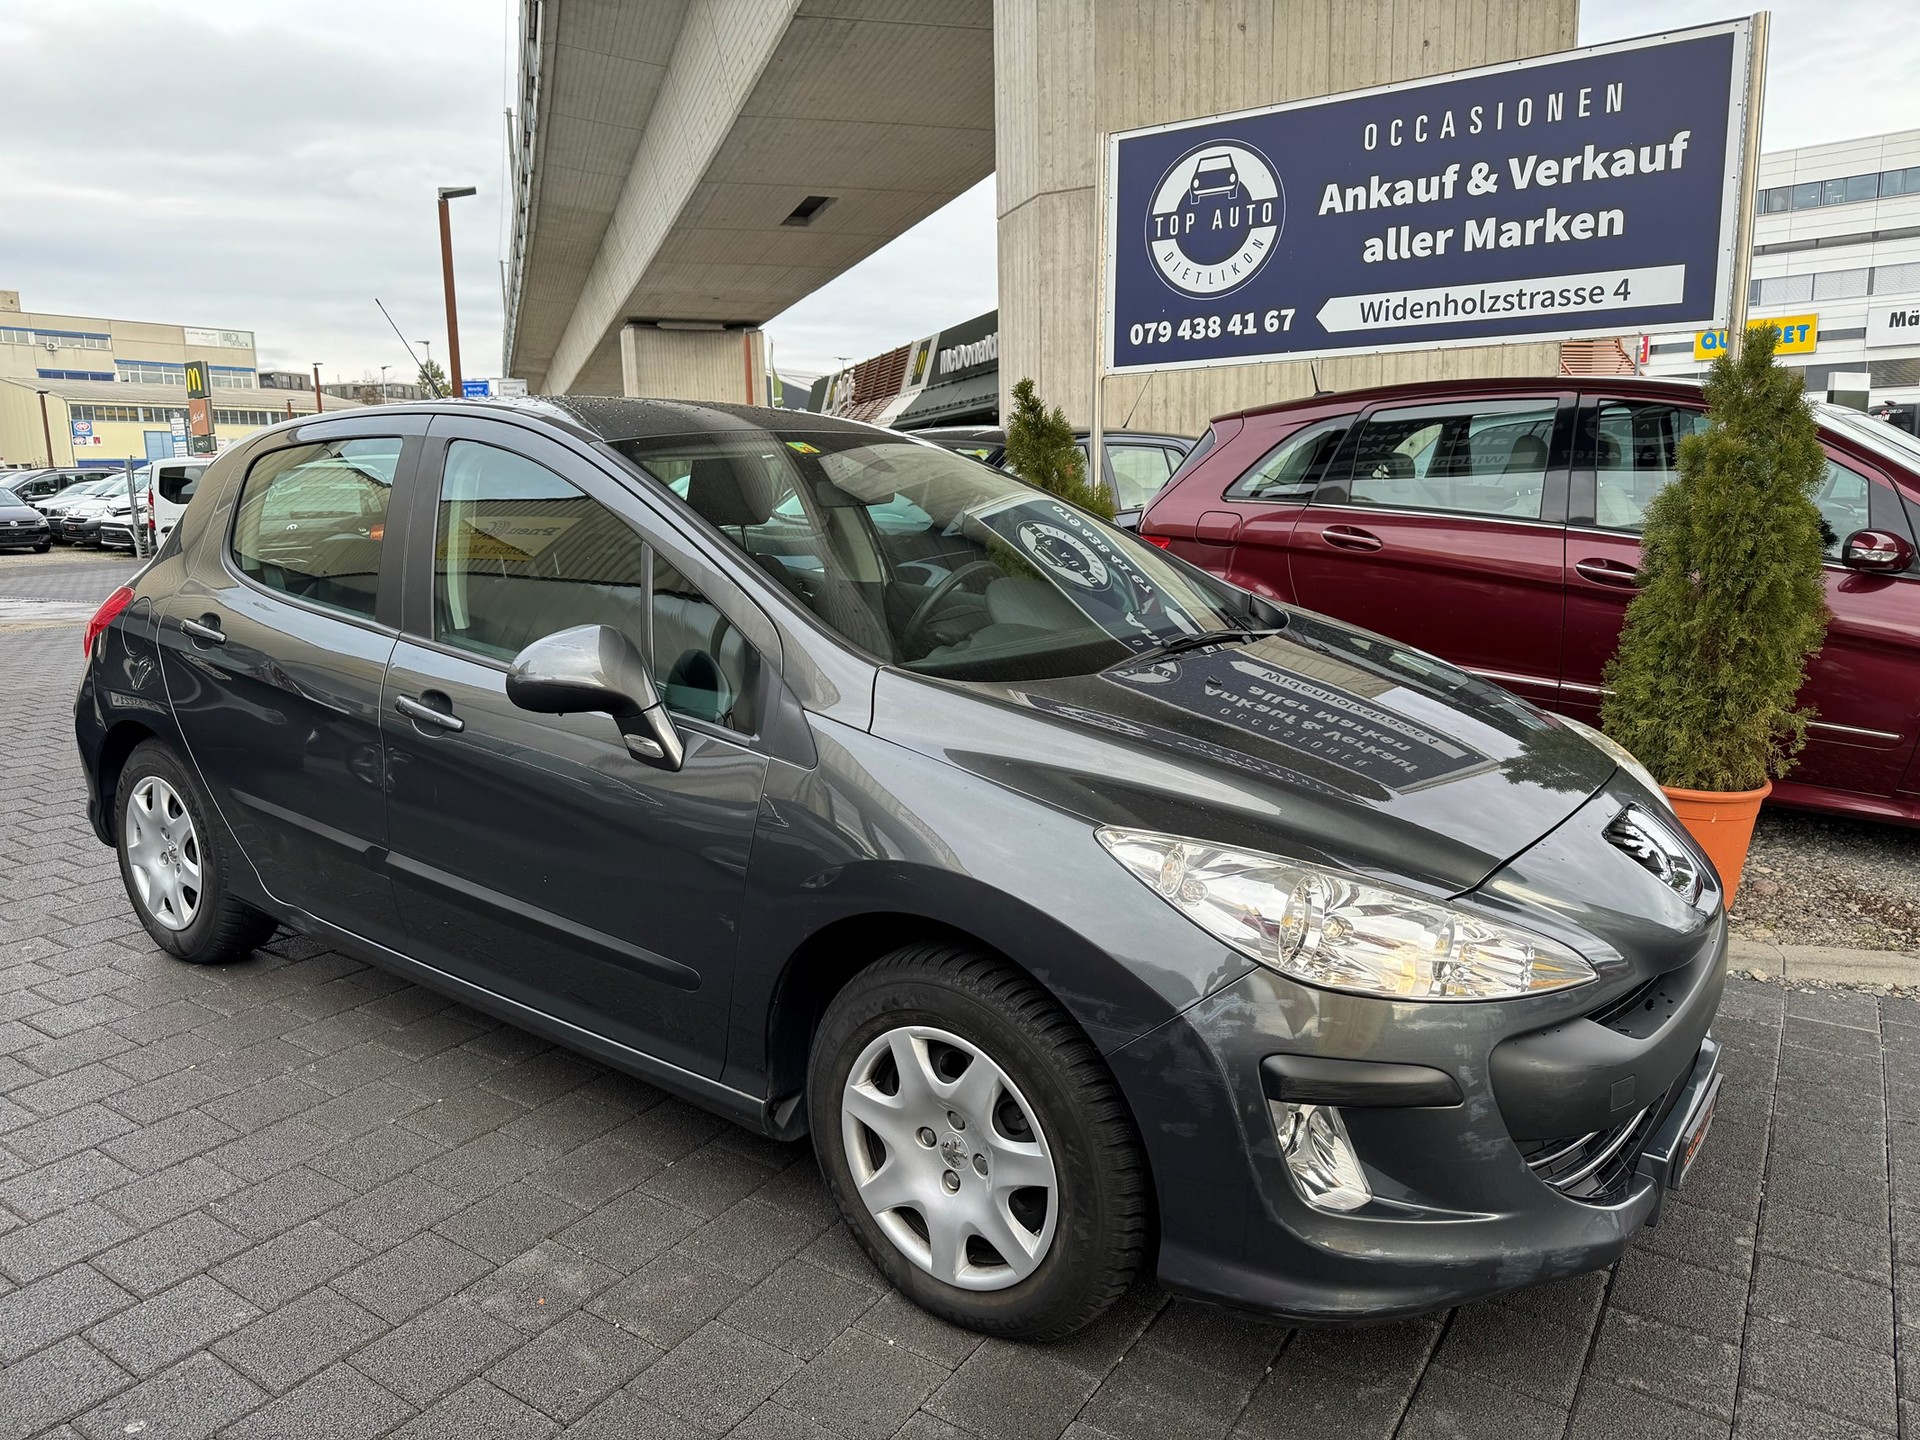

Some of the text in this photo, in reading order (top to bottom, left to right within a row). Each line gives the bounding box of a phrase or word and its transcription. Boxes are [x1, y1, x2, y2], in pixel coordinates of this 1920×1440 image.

[1363, 83, 1623, 151] OCCASIONEN
[1318, 131, 1691, 216] Ankauf & Verkauf
[1155, 202, 1272, 237] TOP AUTO
[1362, 207, 1625, 263] aller Marken
[1163, 238, 1264, 285] DIETLIKON
[1359, 278, 1631, 324] Widenholzstrasse 4
[1889, 310, 1920, 328] Mä
[1130, 308, 1296, 345] 079 438 41 67
